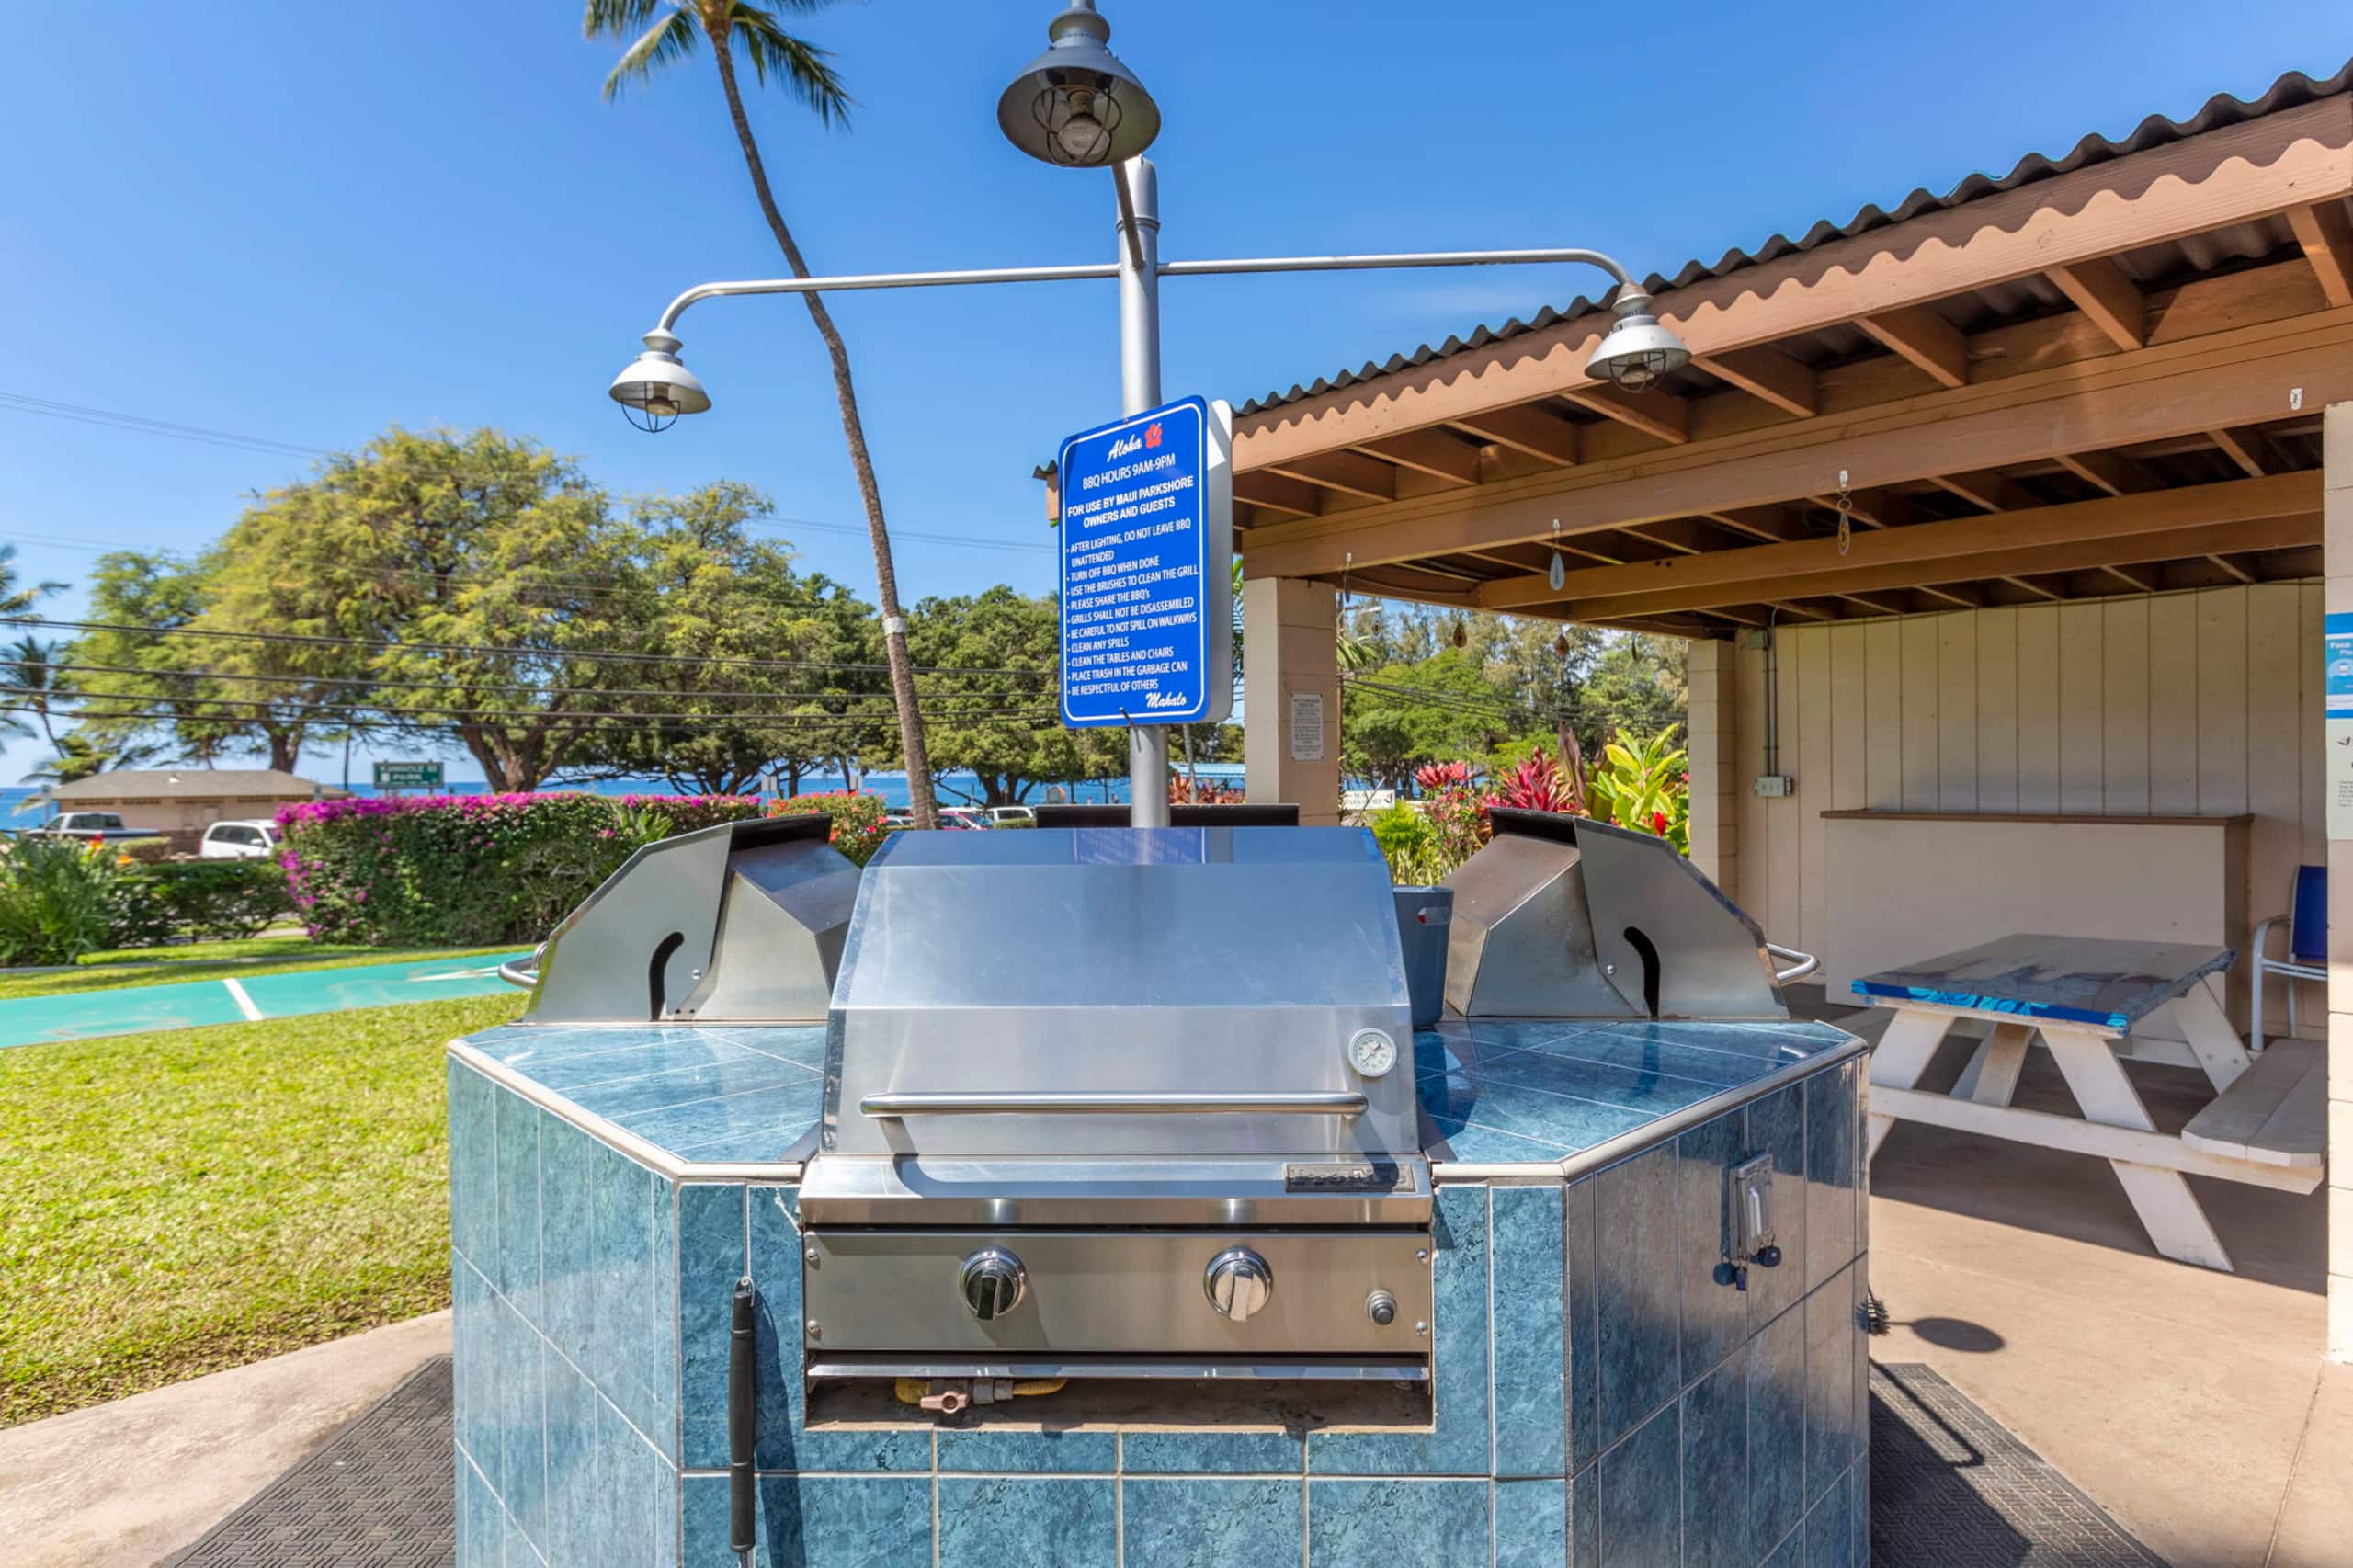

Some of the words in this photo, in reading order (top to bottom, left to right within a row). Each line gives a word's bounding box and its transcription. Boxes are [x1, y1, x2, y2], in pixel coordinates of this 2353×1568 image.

[1107, 434, 1142, 462] Aloha
[1083, 474, 1100, 490] BBQ
[1101, 466, 1131, 485] HOURS
[1132, 452, 1176, 476] 9AM-9PM
[1067, 504, 1085, 517] FOR
[1086, 499, 1102, 513] USE
[1103, 496, 1114, 509] BY
[1116, 489, 1137, 505] MAUI
[1139, 475, 1194, 499] PARKSHORE
[1083, 510, 1119, 528] OWNERS
[1120, 506, 1138, 519] AND
[1140, 495, 1176, 514] GUESTS
[1070, 540, 1089, 553] AFTER
[1124, 530, 1135, 542] DO
[1136, 526, 1151, 540] NOT
[1153, 521, 1175, 536] LEAVE
[1176, 517, 1191, 531] BBQ
[1071, 550, 1115, 568] UNATTENDED
[1071, 570, 1087, 582] TURN
[1088, 566, 1102, 579] OFF
[1102, 564, 1117, 576] BBQ
[1117, 560, 1138, 574] WHEN
[1139, 555, 1160, 569] DONE
[1071, 585, 1083, 597] USE
[1084, 582, 1097, 594] THE
[1097, 577, 1127, 592] BRUSHES
[1128, 574, 1137, 586] TO
[1138, 570, 1161, 585] CLEAN
[1162, 567, 1176, 581] THE
[1176, 564, 1199, 577] GRILL
[1071, 597, 1094, 610] PLEASE
[1095, 594, 1116, 607] SHARE
[1117, 591, 1131, 603] THE
[1071, 612, 1092, 625] GRILLS
[1093, 608, 1114, 621] SHALL
[1115, 607, 1129, 618] NOT
[1130, 605, 1139, 616] BE
[1140, 597, 1194, 615] DISASSEMBLED
[1071, 629, 1079, 640] BE
[1079, 625, 1106, 639] CAREFUL
[1106, 623, 1115, 635] TO
[1115, 621, 1129, 633] NOT
[1130, 619, 1147, 631] SPILL
[1147, 617, 1159, 629] ON
[1159, 611, 1197, 628] WALKWAYS
[1071, 642, 1093, 653] CLEAN
[1093, 639, 1107, 651] ANY
[1107, 636, 1130, 649] SPILLS
[1071, 655, 1092, 667] CLEAN
[1093, 653, 1106, 665] THE
[1106, 651, 1130, 664] TABLES
[1131, 649, 1147, 661] AND
[1147, 646, 1174, 659] CHAIRS
[1072, 670, 1091, 682] PLACE
[1092, 667, 1113, 680] TRASH
[1114, 666, 1122, 677] IN
[1122, 665, 1136, 676] THE
[1136, 662, 1170, 676] GARBAGE
[1171, 661, 1188, 673] CAN
[1072, 685, 1080, 697] BE
[1080, 682, 1120, 696] RESPECTFUL
[1120, 680, 1131, 692] OF
[1131, 678, 1159, 691] OTHERS
[1145, 691, 1187, 708] Mahalo
